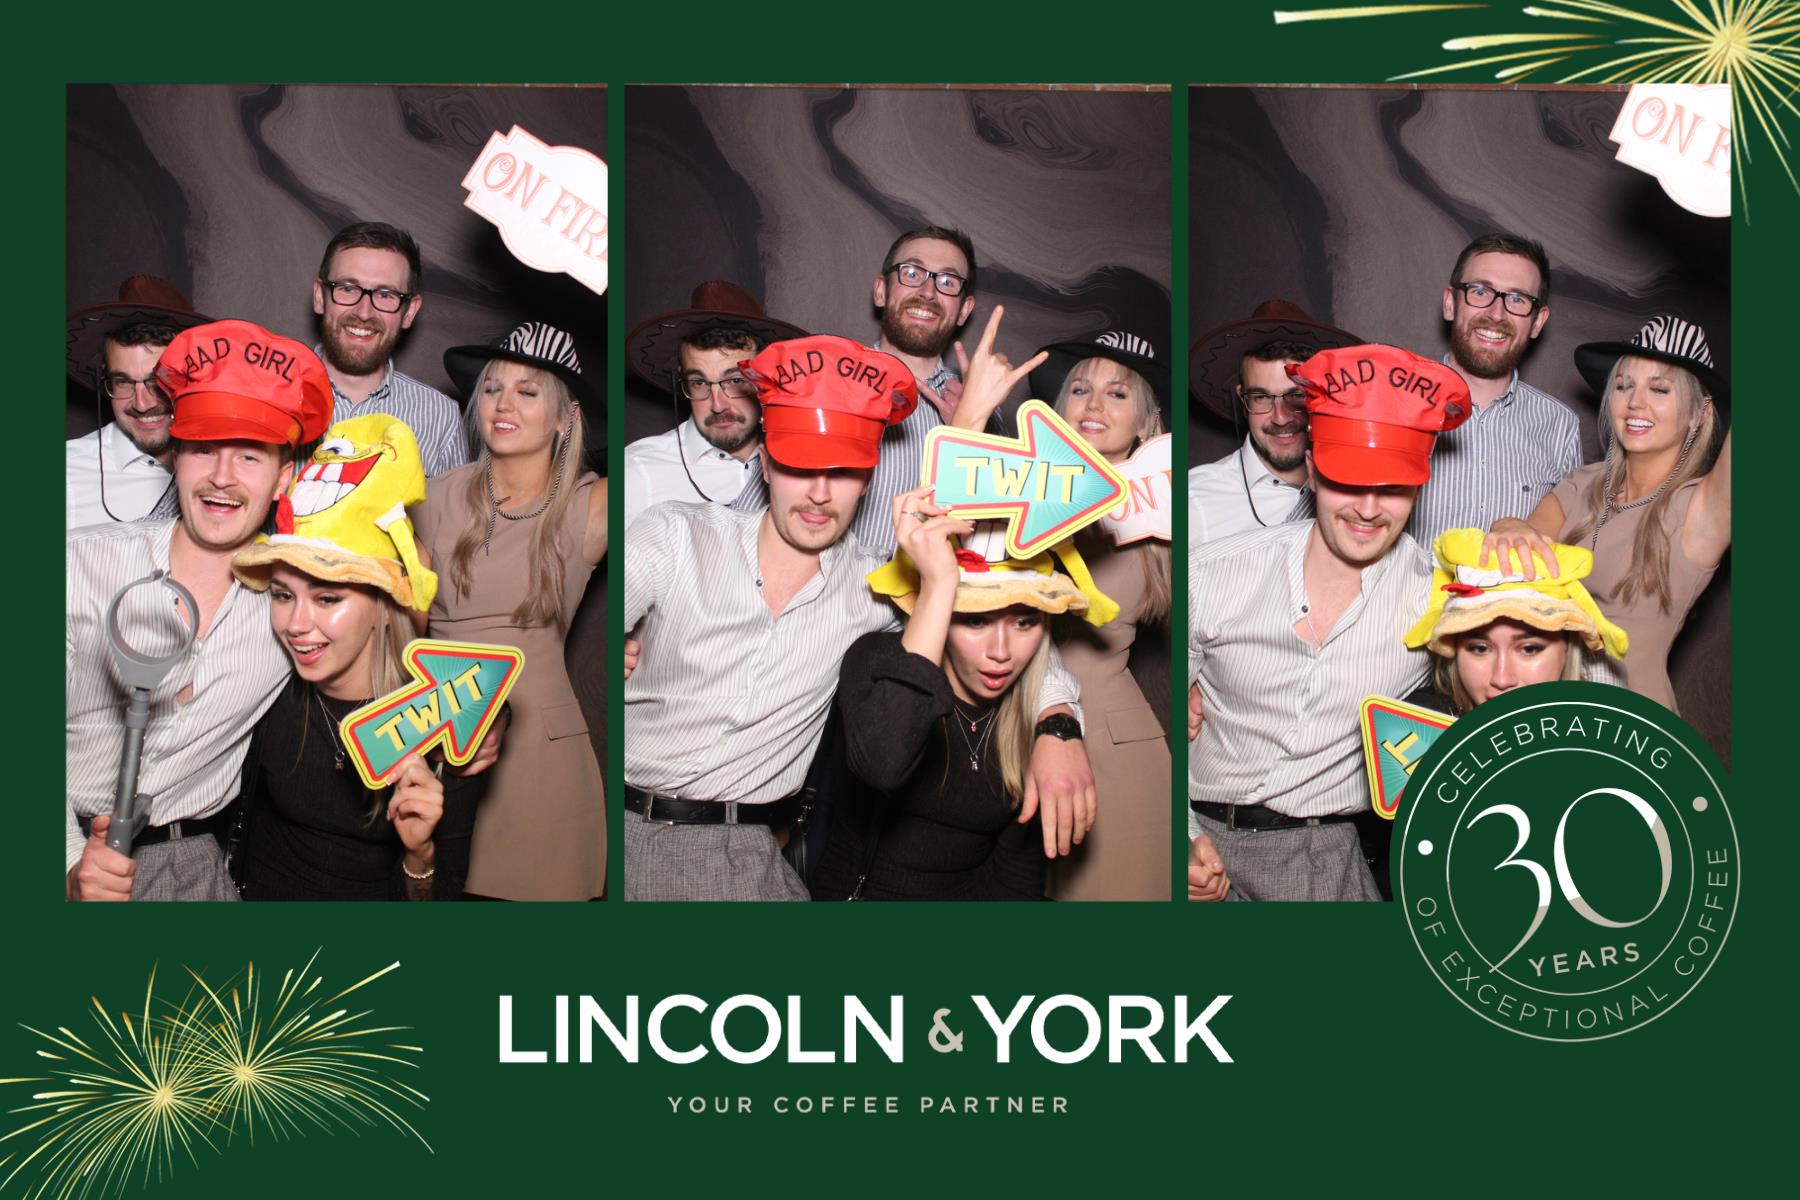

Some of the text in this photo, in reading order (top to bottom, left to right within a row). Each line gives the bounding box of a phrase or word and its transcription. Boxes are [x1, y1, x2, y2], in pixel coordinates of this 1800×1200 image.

[1632, 96, 1704, 155] ON
[483, 152, 608, 263] ON FIR
[185, 337, 296, 384] BAD GIRL
[775, 350, 888, 396] BAD GIRL
[1324, 359, 1441, 408] BAD GIRL
[955, 456, 1086, 504] TWIT
[374, 661, 483, 752] TWIT
